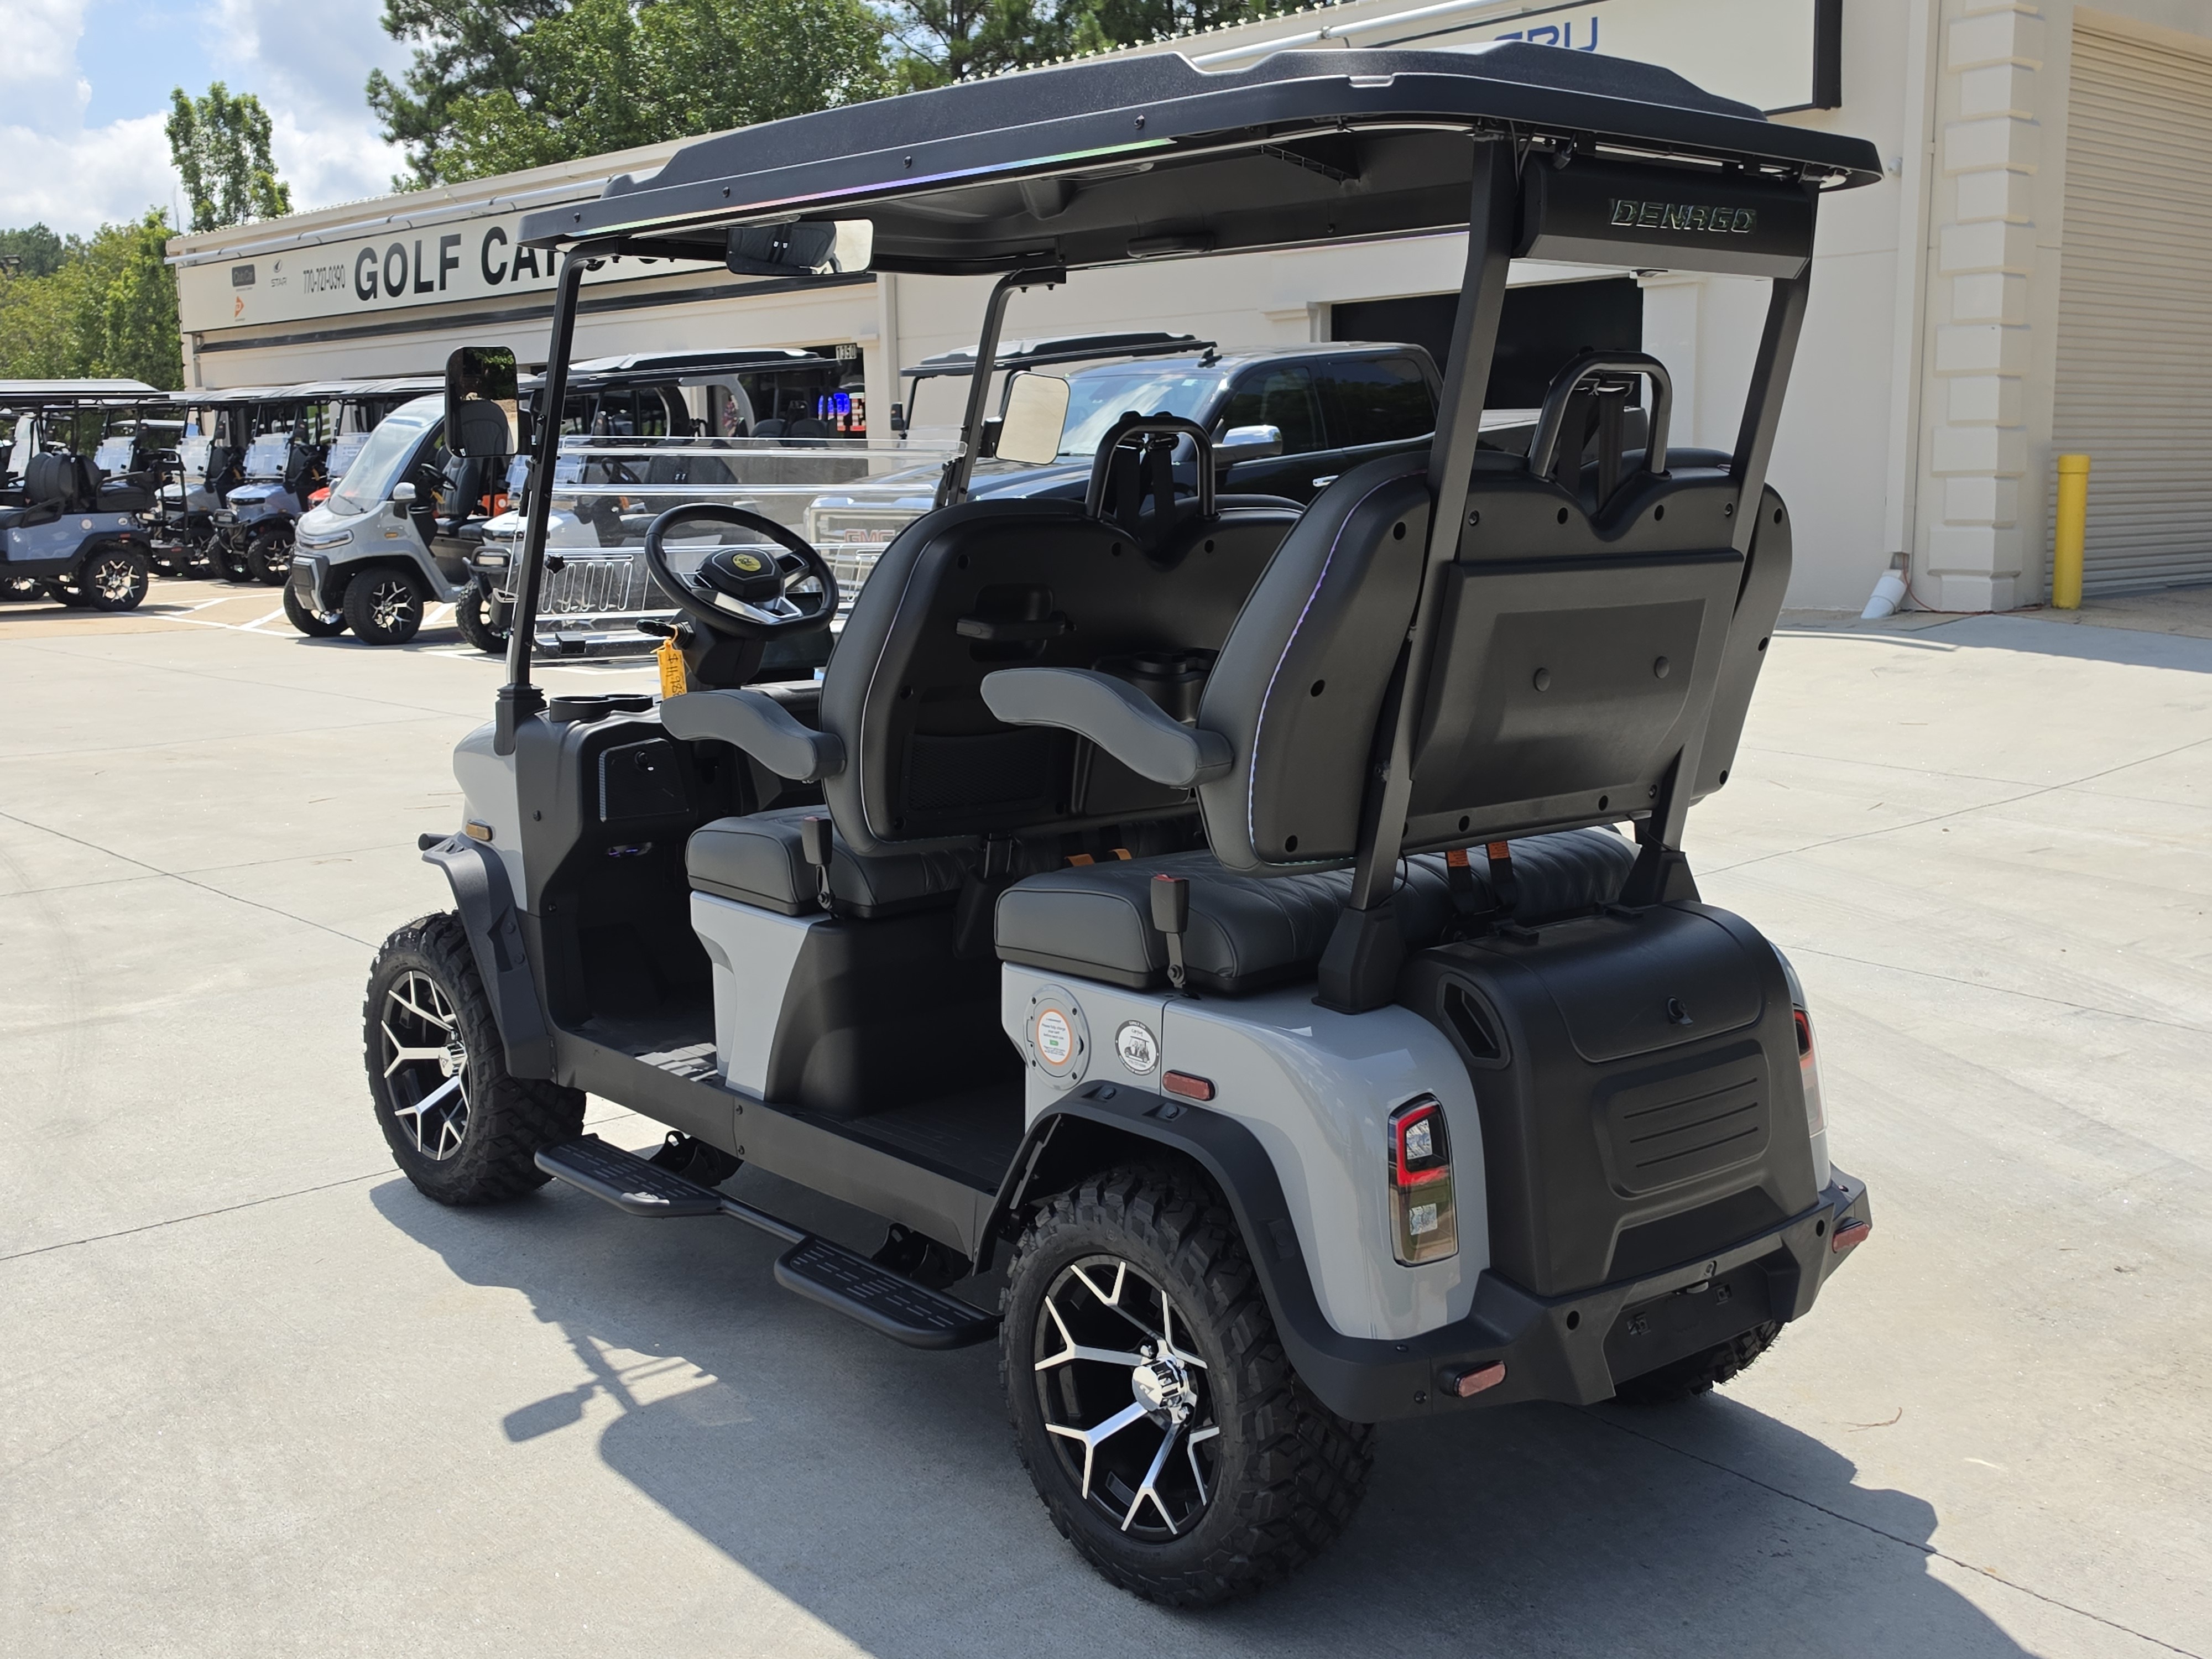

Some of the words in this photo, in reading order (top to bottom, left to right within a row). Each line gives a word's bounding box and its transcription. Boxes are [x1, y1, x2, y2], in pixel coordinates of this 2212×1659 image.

[1494, 17, 1598, 52] RU
[1610, 199, 1756, 233] DENAGO
[270, 277, 288, 287] STAR
[354, 233, 462, 301] GOLF
[837, 345, 855, 358] 1350
[818, 392, 866, 431] OPE
[844, 528, 896, 542] GMC
